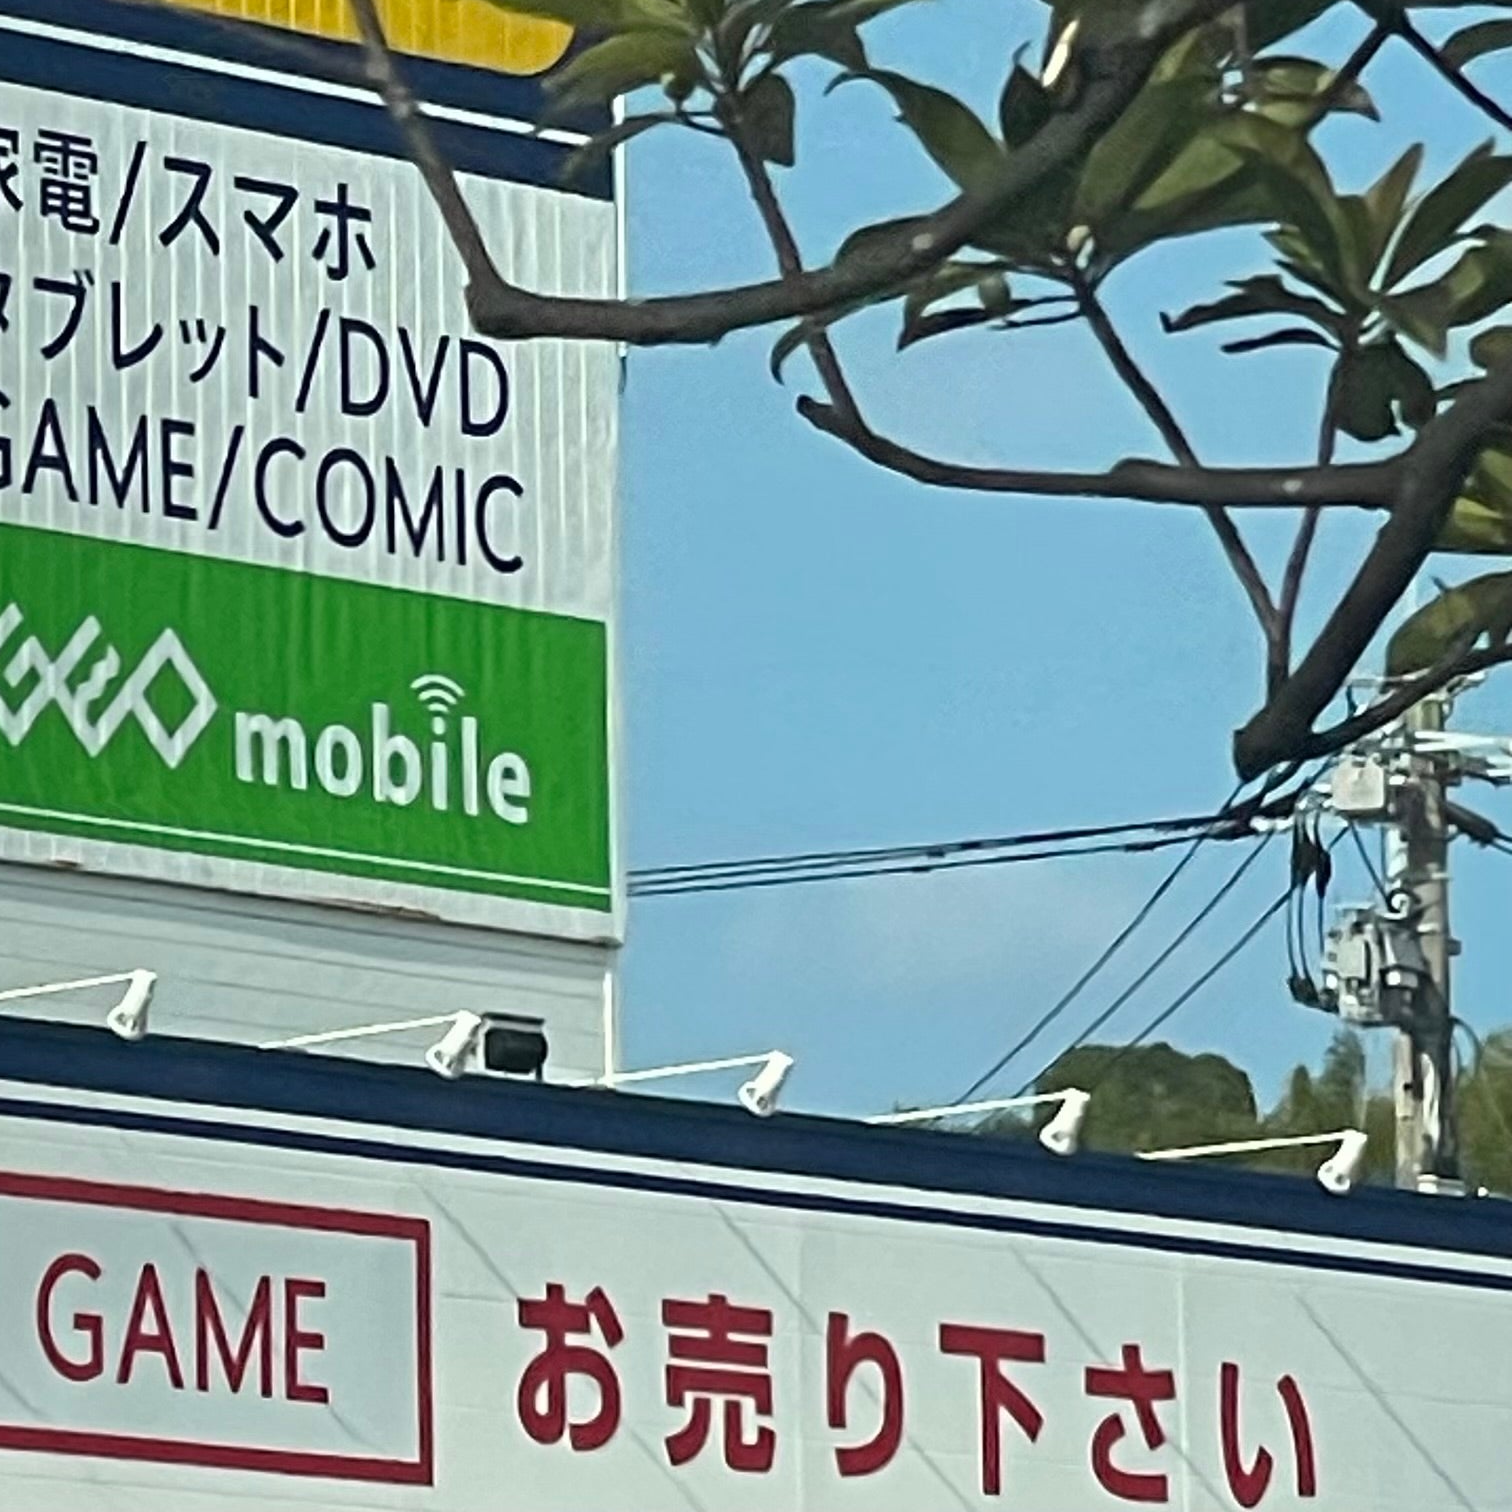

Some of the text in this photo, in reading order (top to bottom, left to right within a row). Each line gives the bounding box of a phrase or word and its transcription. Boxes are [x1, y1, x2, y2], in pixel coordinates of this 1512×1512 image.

[234, 702, 531, 823] mobile
[36, 1252, 330, 1404] GAME
[515, 1282, 1317, 1509] お売り下さい
